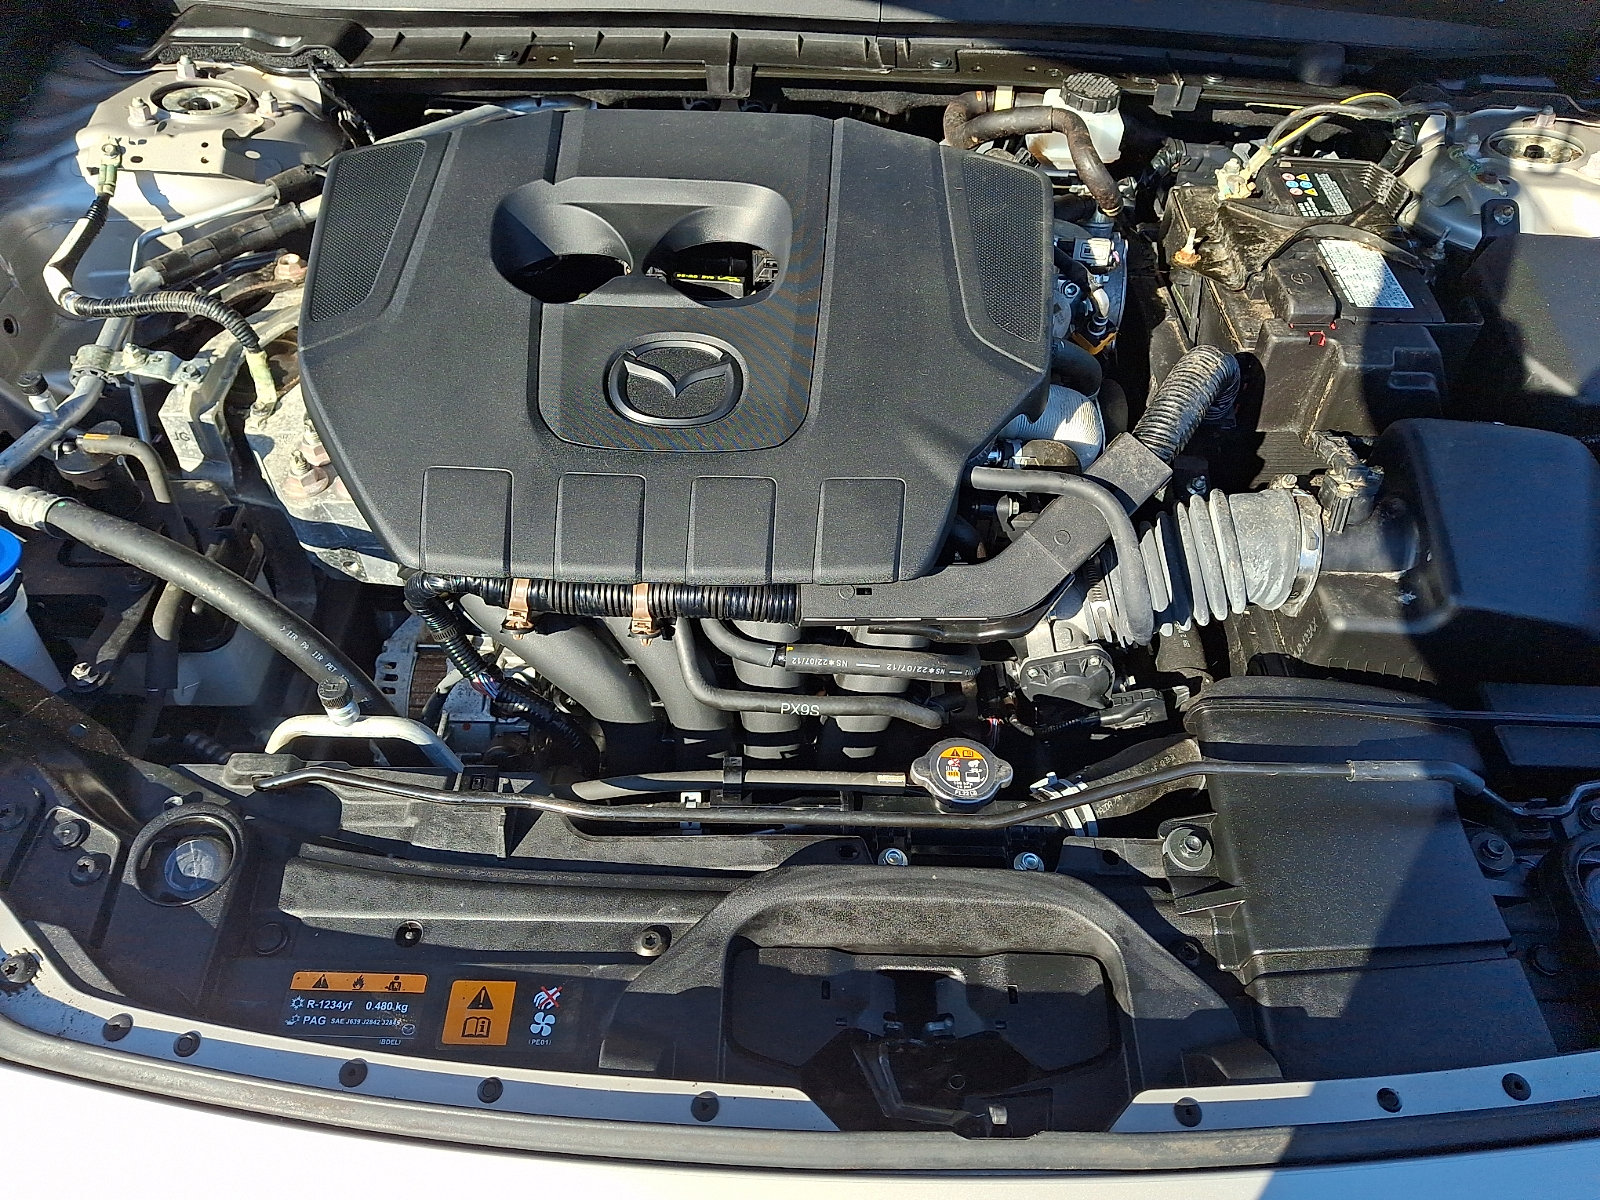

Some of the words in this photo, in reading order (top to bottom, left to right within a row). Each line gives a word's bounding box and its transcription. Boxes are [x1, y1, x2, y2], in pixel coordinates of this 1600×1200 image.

[325, 662, 338, 673] PET
[780, 703, 820, 716] PX9S
[307, 1000, 353, 1012] R-1234yf
[366, 1001, 393, 1011] 0.480
[395, 1001, 409, 1013] kg
[302, 1016, 327, 1025] PAG
[361, 1018, 381, 1026] J2842
